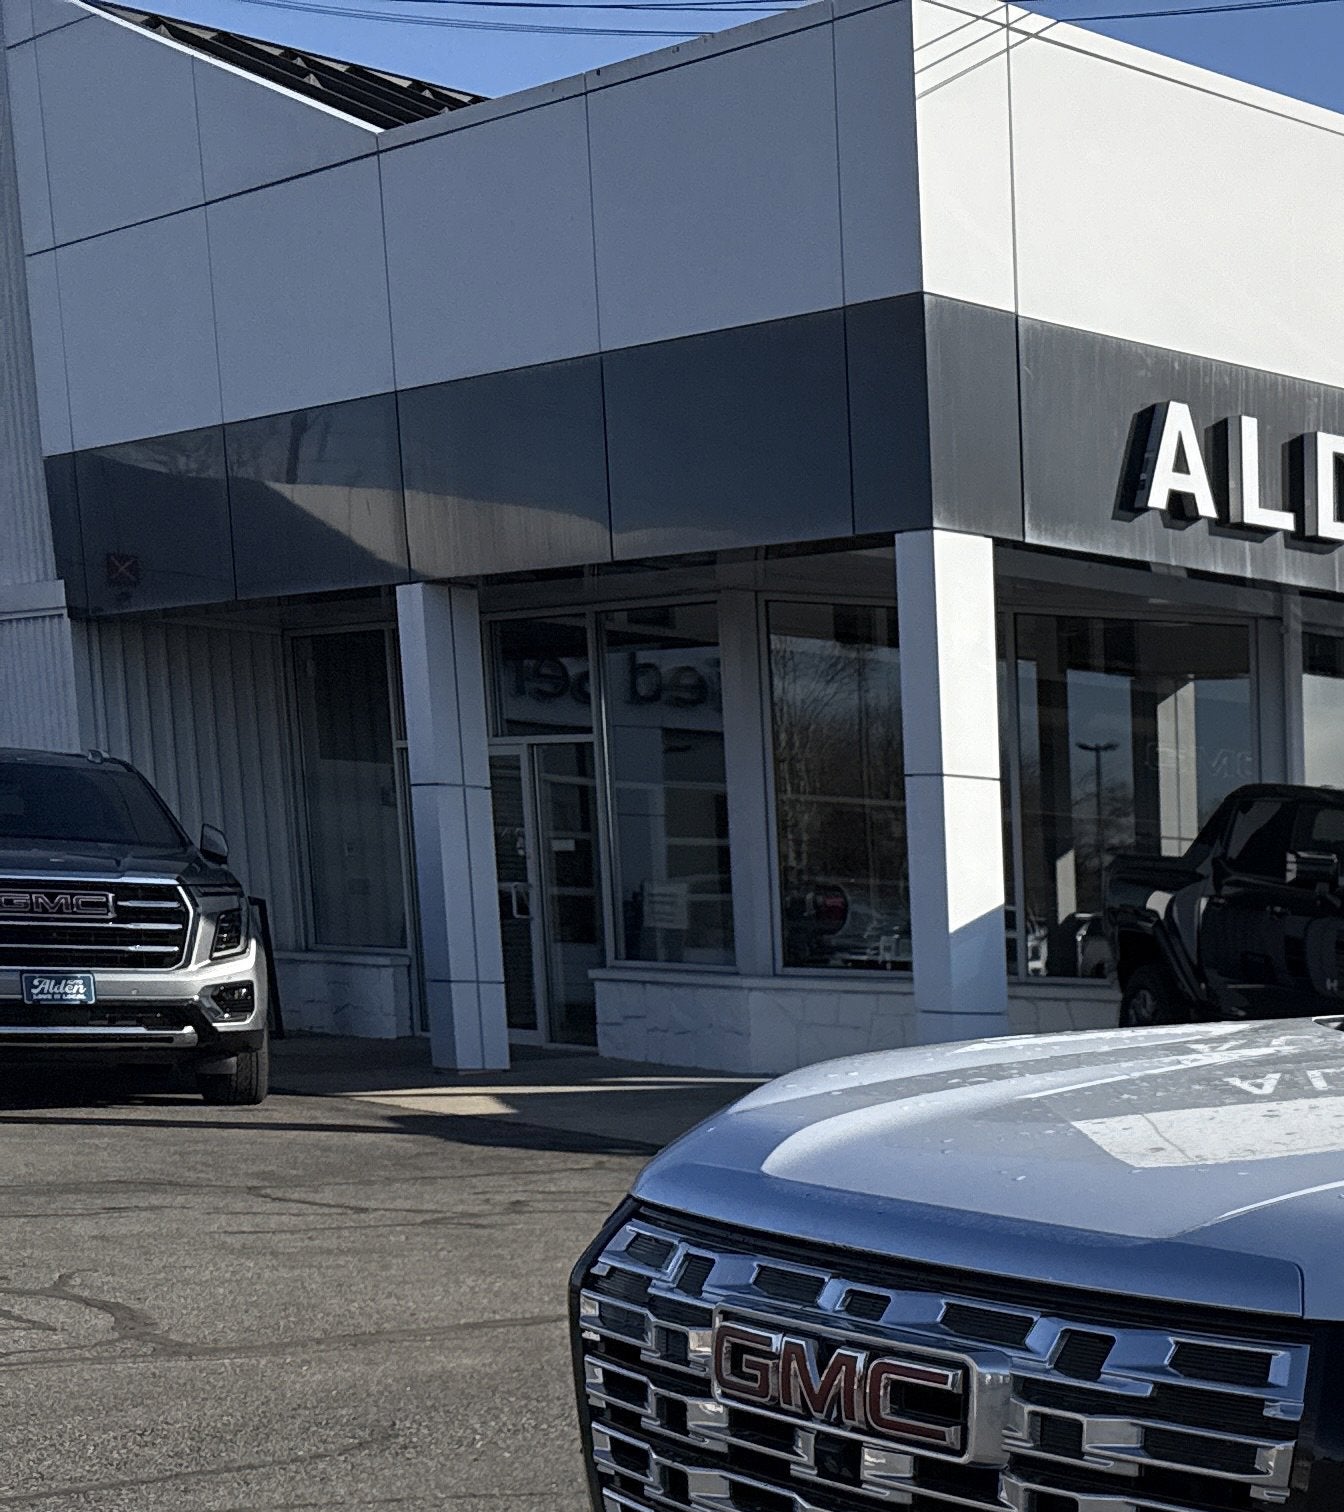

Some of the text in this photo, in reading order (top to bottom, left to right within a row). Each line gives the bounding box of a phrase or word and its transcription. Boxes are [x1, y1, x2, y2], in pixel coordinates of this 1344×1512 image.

[0, 893, 108, 914] GMC
[31, 977, 87, 994] Alden
[713, 1323, 963, 1450] GMC
